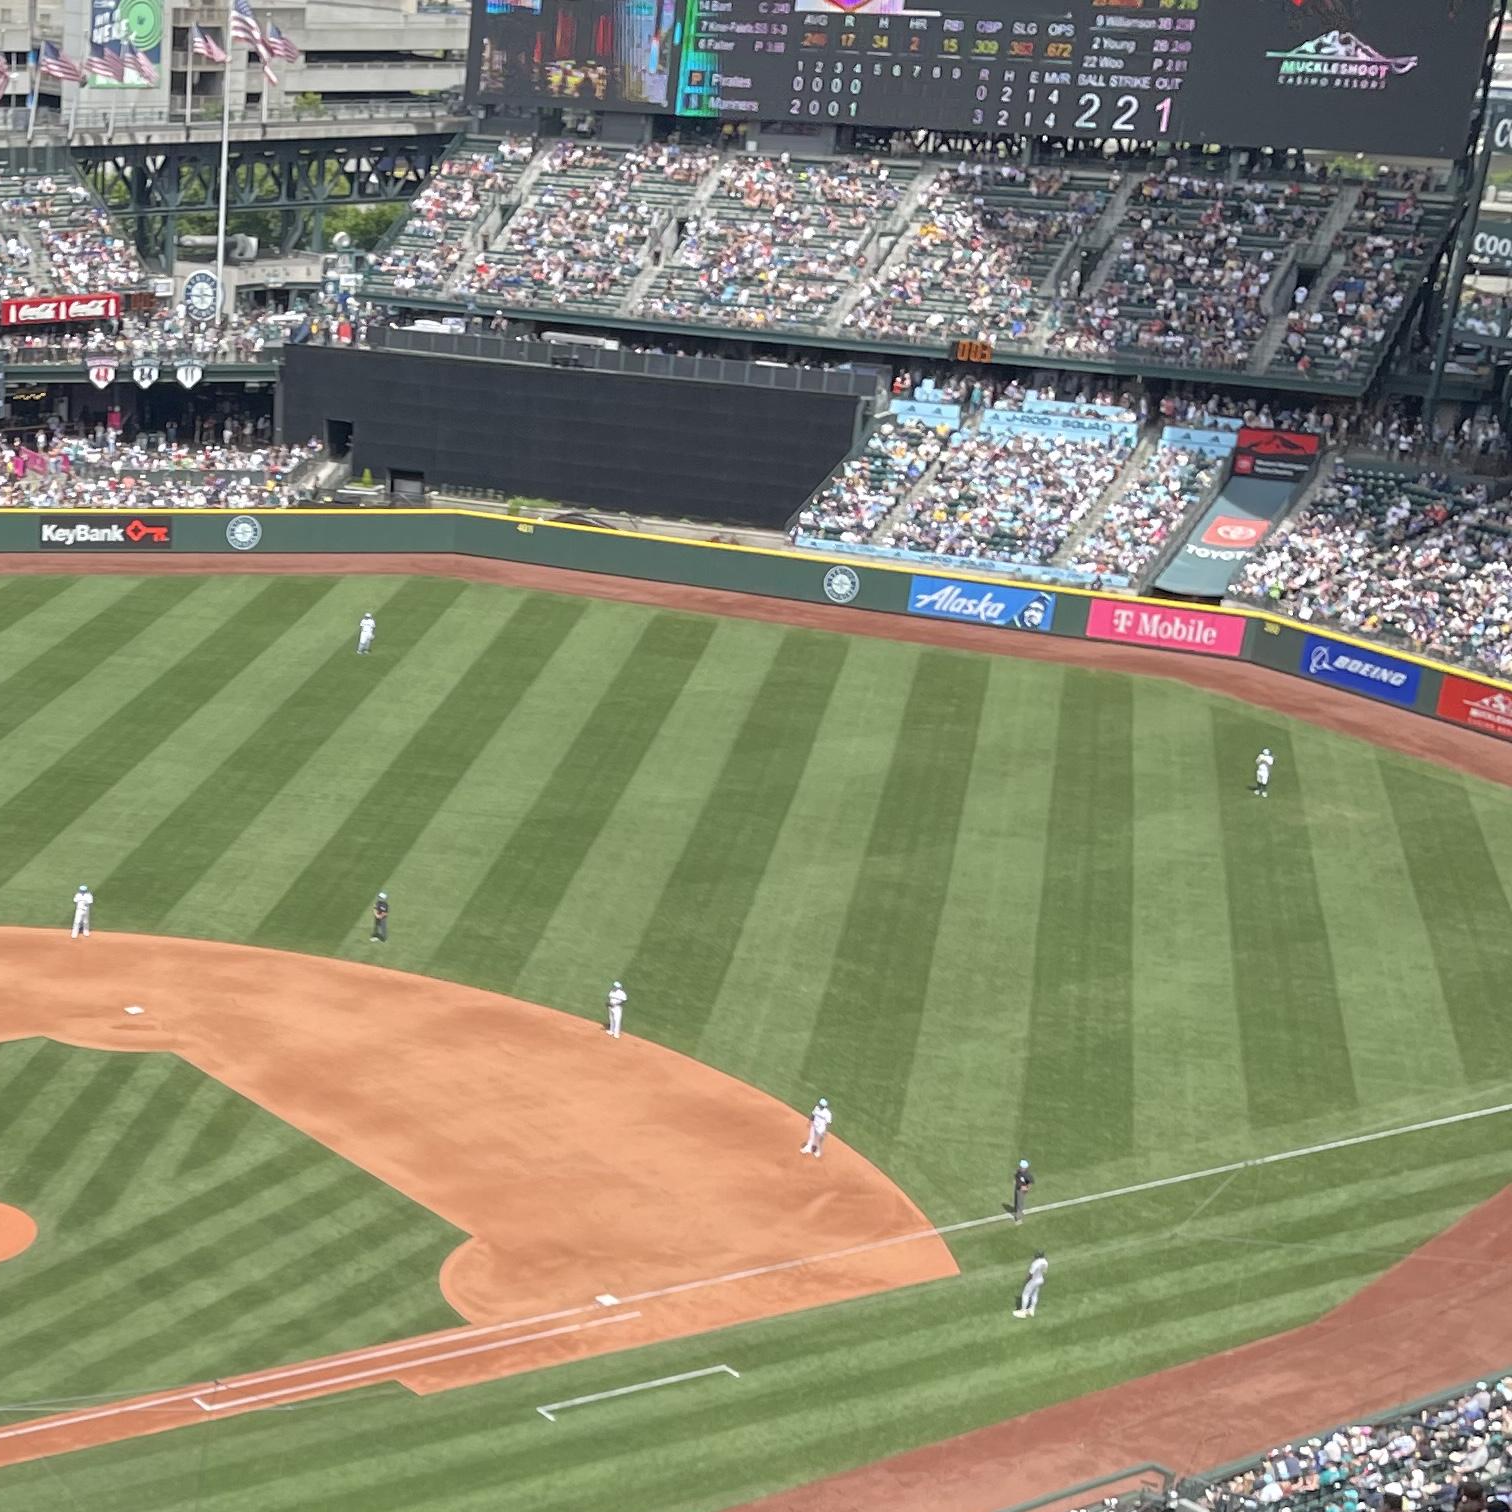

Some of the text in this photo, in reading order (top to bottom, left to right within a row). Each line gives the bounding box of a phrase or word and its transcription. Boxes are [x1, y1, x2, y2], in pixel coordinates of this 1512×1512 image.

[852, 63, 862, 74] 4
[1004, 70, 1016, 82] H
[1029, 71, 1039, 84] E
[1077, 73, 1184, 91] BALL STRIKE OUT
[1280, 60, 1389, 79] MUCKLESHOOT
[792, 76, 804, 91] 0
[811, 77, 823, 92] 0
[830, 78, 843, 93] 0
[850, 79, 862, 95] 0
[976, 85, 988, 101] 0
[1000, 86, 1013, 102] 2
[1028, 88, 1036, 103] 1
[1048, 89, 1060, 104] 4
[789, 99, 801, 115] 2
[808, 100, 821, 116] 0
[828, 101, 840, 117] 0
[848, 101, 858, 117] 1
[972, 108, 984, 125] 3
[997, 110, 1010, 126] 2
[1024, 111, 1032, 127] 1
[1044, 112, 1056, 129] 4
[1074, 93, 1172, 133] 2 2 1
[41, 524, 125, 545] KeyBank
[914, 585, 1007, 623] Alaska
[1137, 612, 1217, 646] Mobile
[1333, 655, 1408, 687] BOEING
